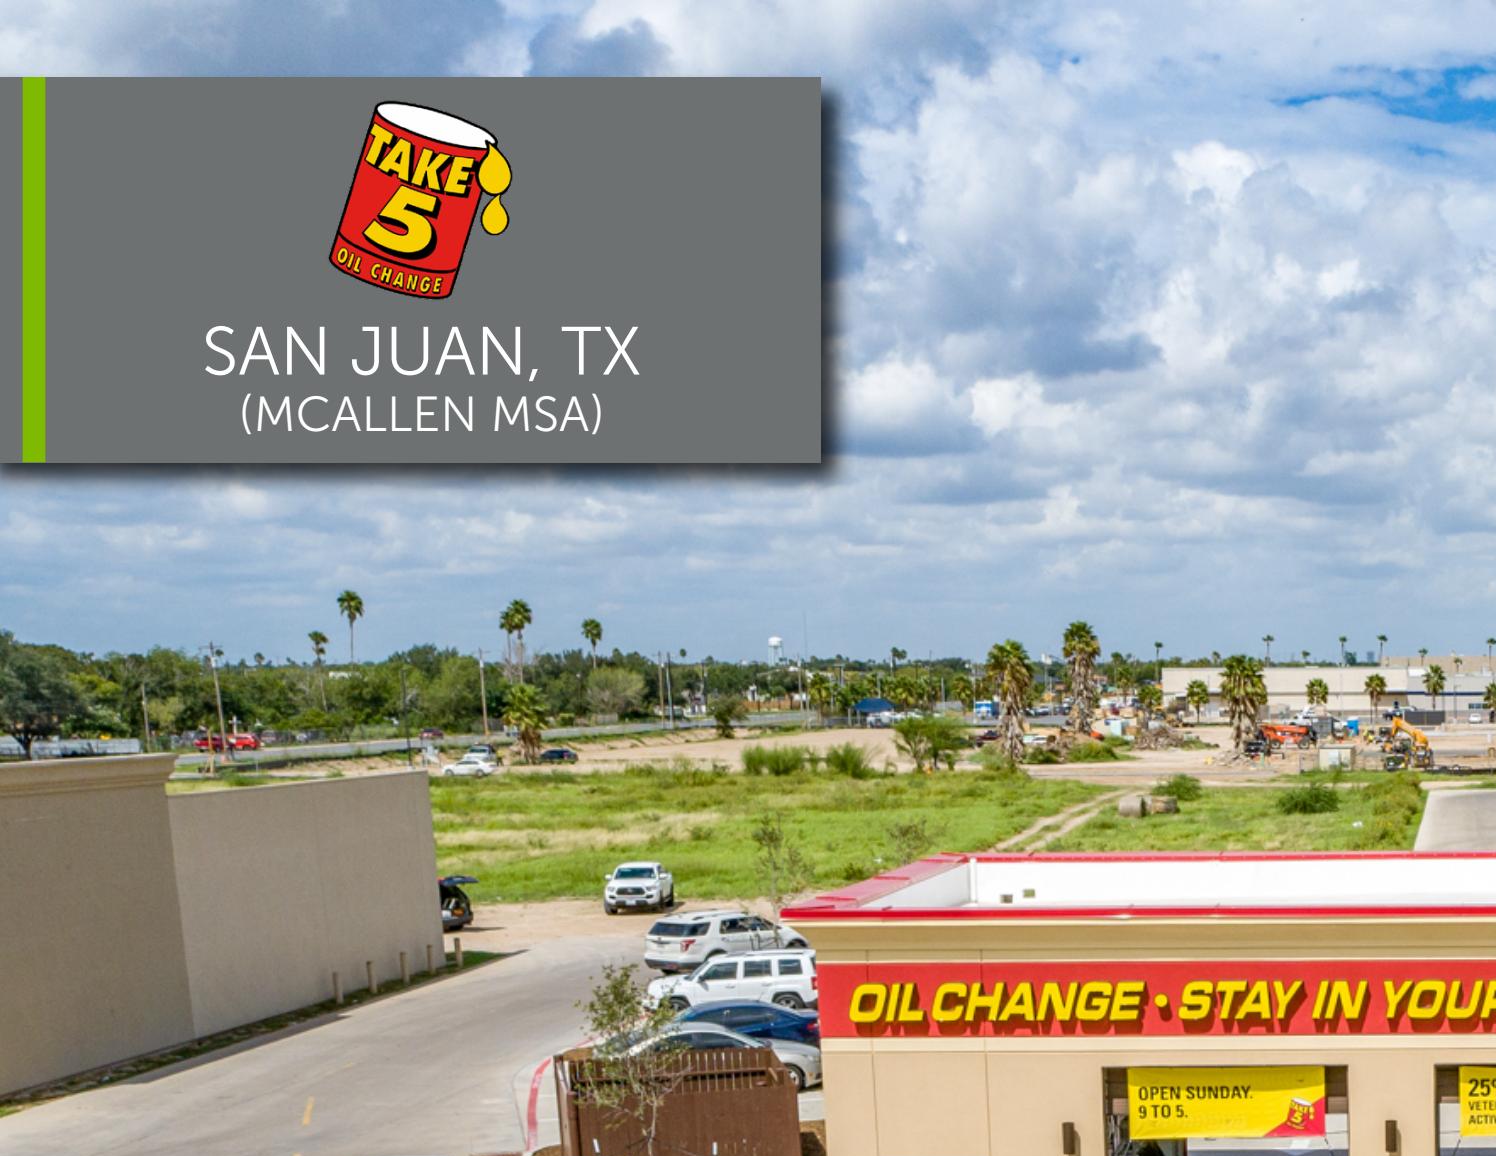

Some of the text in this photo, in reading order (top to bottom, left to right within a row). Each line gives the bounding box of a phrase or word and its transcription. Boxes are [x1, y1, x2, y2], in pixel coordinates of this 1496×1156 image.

[848, 983, 925, 1023] OIL
[931, 981, 1146, 1022] CHANGE
[1178, 980, 1302, 1020] STAY
[1312, 980, 1368, 1020] IN
[1138, 1085, 1253, 1101] OPEN SUNDAY.
[1139, 1105, 1188, 1119] 9 TO 5.
